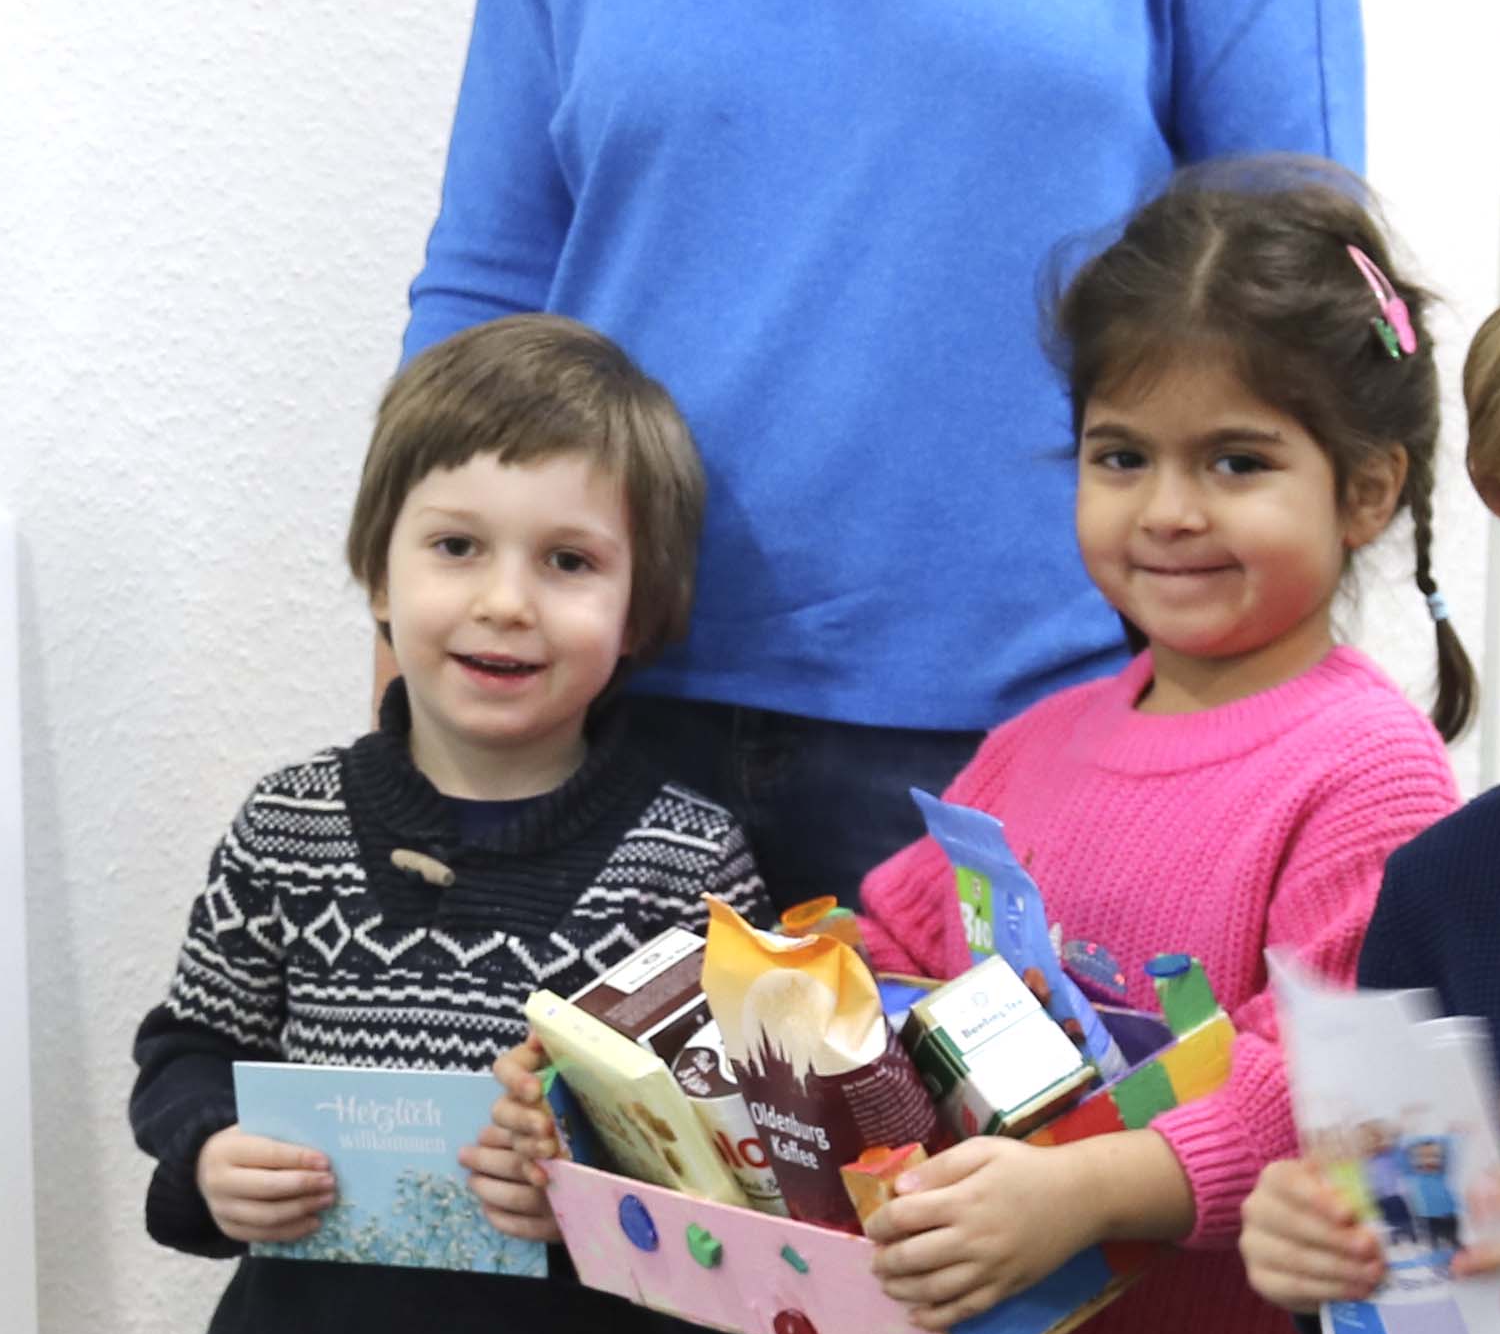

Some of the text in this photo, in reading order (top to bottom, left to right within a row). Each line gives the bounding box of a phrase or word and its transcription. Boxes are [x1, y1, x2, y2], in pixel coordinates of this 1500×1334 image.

[313, 1094, 441, 1133] Herzlich
[750, 1101, 831, 1151] Oldenburg
[770, 1134, 820, 1170] Kaffee
